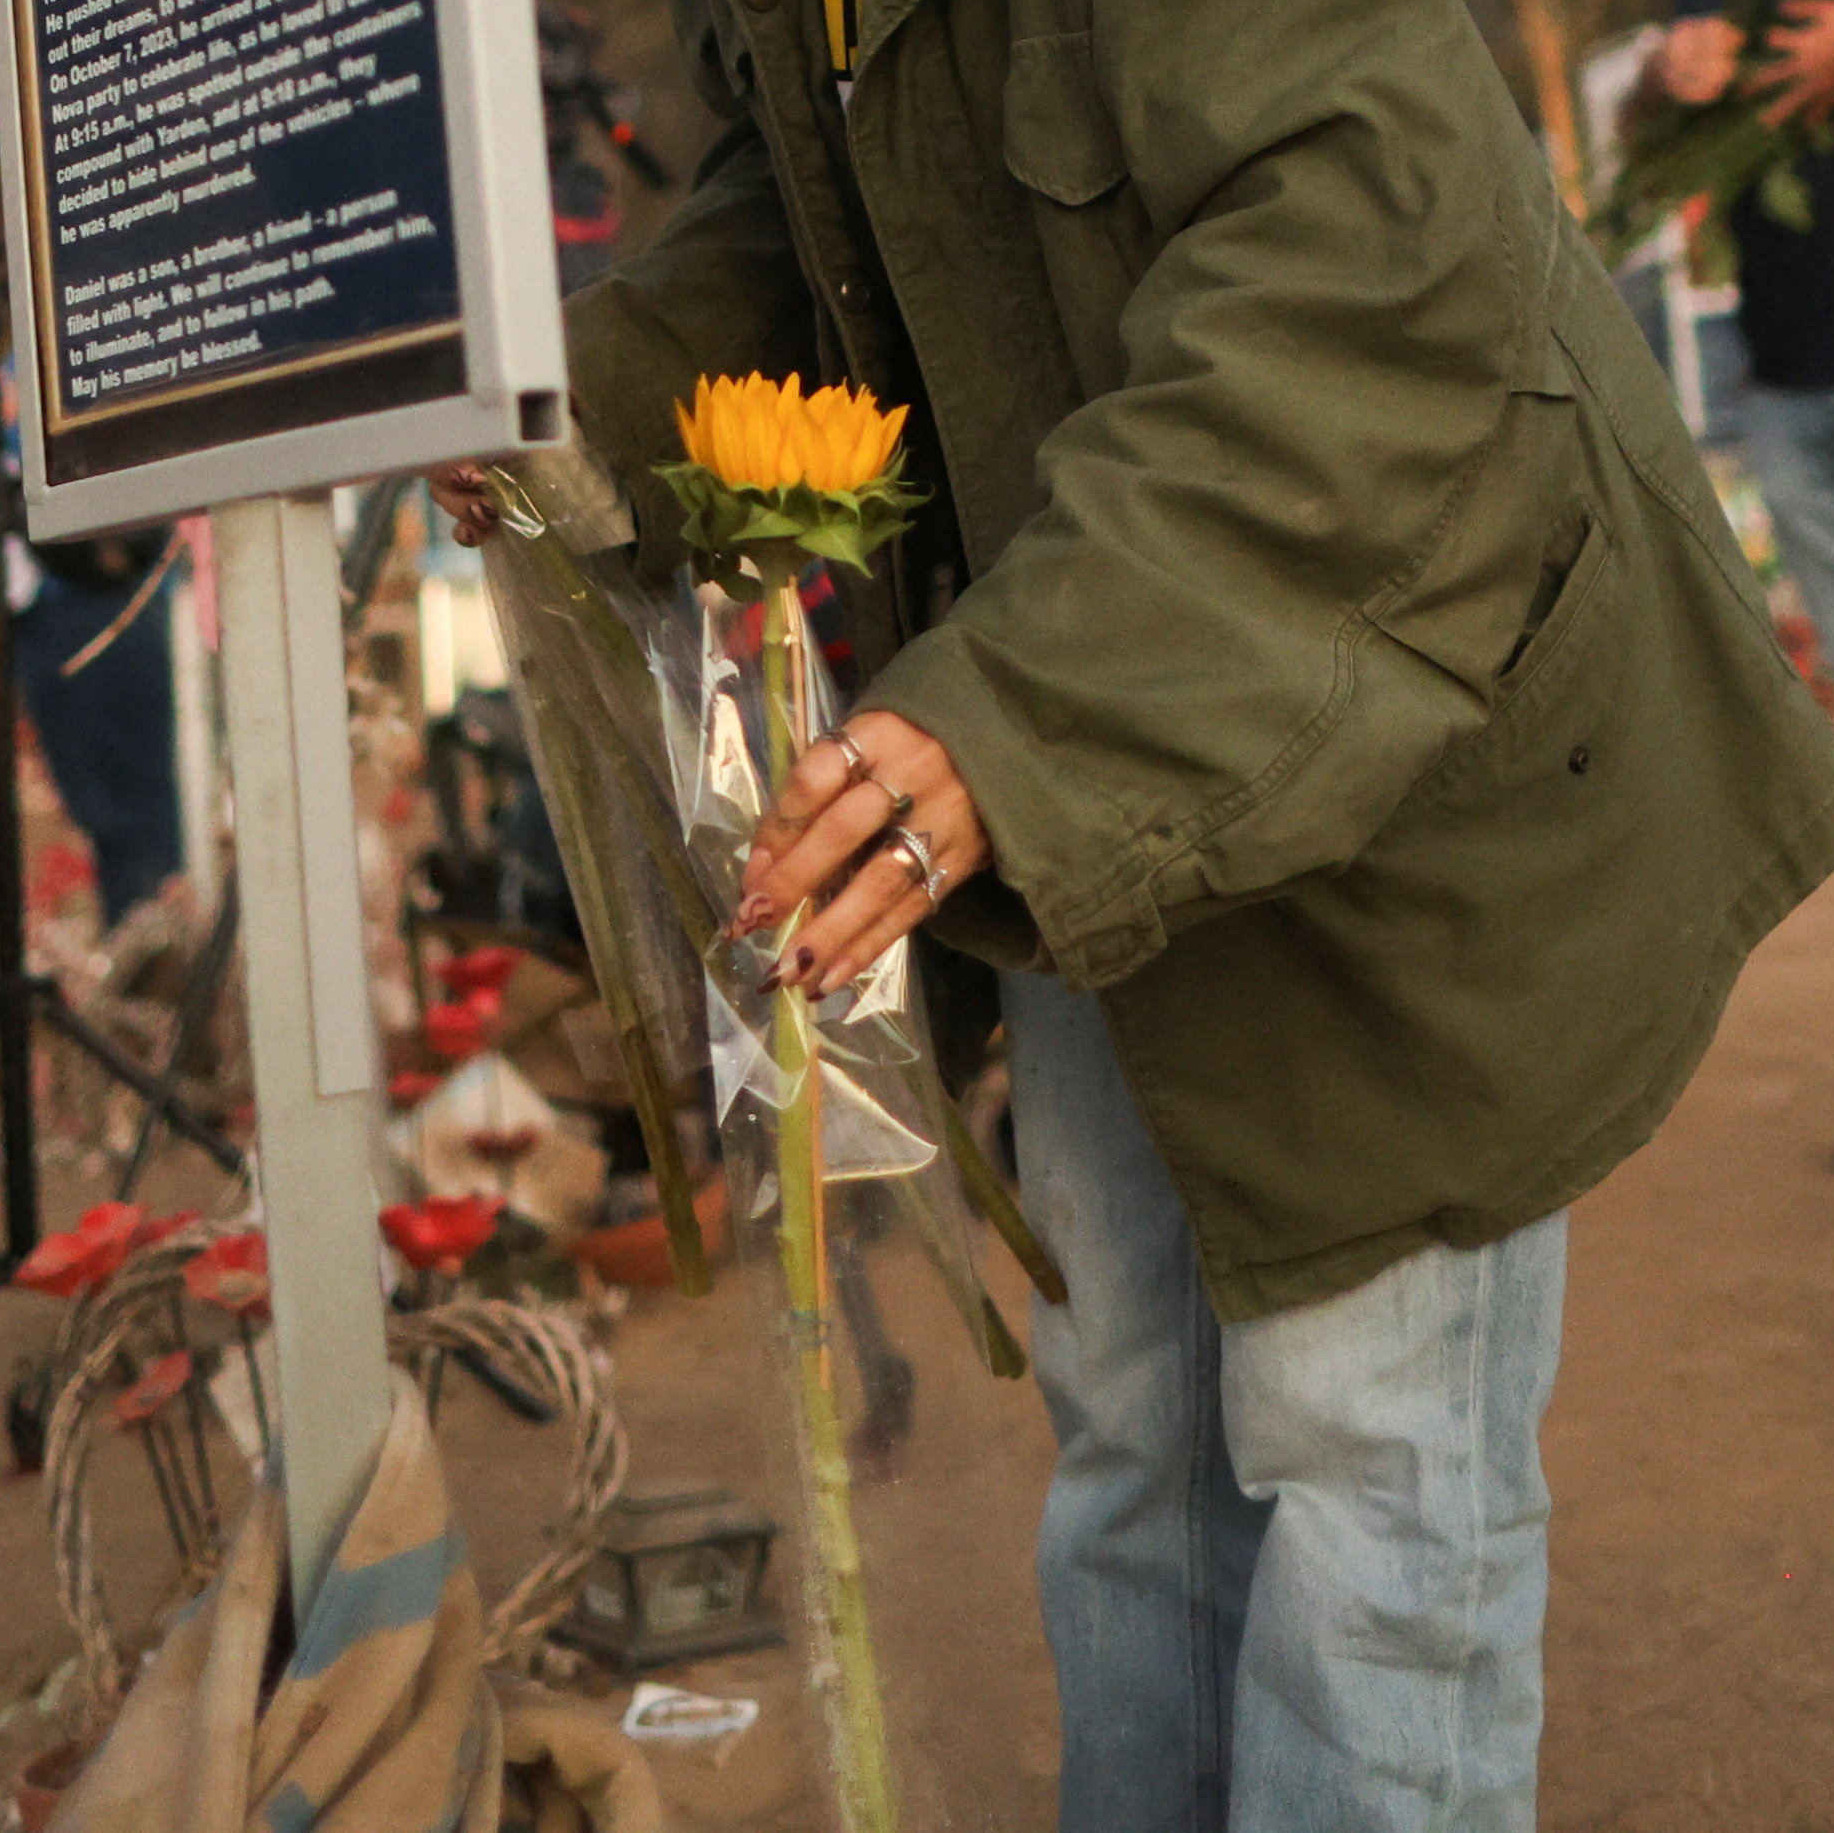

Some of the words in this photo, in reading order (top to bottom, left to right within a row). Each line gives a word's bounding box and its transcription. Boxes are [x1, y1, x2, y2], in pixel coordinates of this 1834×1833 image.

[46, 14, 63, 34] He
[48, 41, 68, 63] out
[72, 27, 101, 54] their
[104, 8, 157, 40] dreams,
[50, 74, 67, 93] On
[71, 53, 120, 85] October
[123, 43, 137, 63] 7,
[140, 27, 178, 57] 2023,
[180, 21, 198, 40] he
[52, 100, 84, 124] Nova
[87, 84, 120, 115] party
[123, 77, 138, 95] to
[140, 51, 206, 89] celebrate
[55, 134, 69, 154] At
[71, 120, 99, 147] 9:15
[136, 104, 153, 122] he
[156, 92, 185, 114] was
[188, 65, 242, 105] spotted
[57, 143, 122, 184] compound
[125, 132, 154, 159] with
[213, 99, 240, 127] and
[59, 180, 108, 214] decided
[111, 178, 125, 196] to
[128, 165, 157, 189] hide
[160, 144, 207, 178] behind
[210, 139, 237, 161] one
[61, 226, 76, 244] he
[79, 218, 105, 238] was
[109, 190, 179, 230] apparently
[65, 276, 105, 305] Daniel
[108, 271, 136, 291] was
[138, 268, 147, 283] a
[150, 259, 179, 279] son,
[182, 254, 191, 270] a
[67, 309, 99, 335] filled
[102, 302, 131, 326] with
[134, 291, 168, 318] light.
[171, 284, 192, 305] We
[195, 273, 222, 298] will
[70, 349, 83, 366] to
[86, 330, 154, 362] illuminate,
[158, 318, 183, 342] and
[185, 316, 201, 334] to
[203, 305, 248, 328] follow
[72, 377, 97, 397] May
[101, 369, 121, 389] his
[123, 357, 177, 383] memory
[180, 349, 199, 368] be
